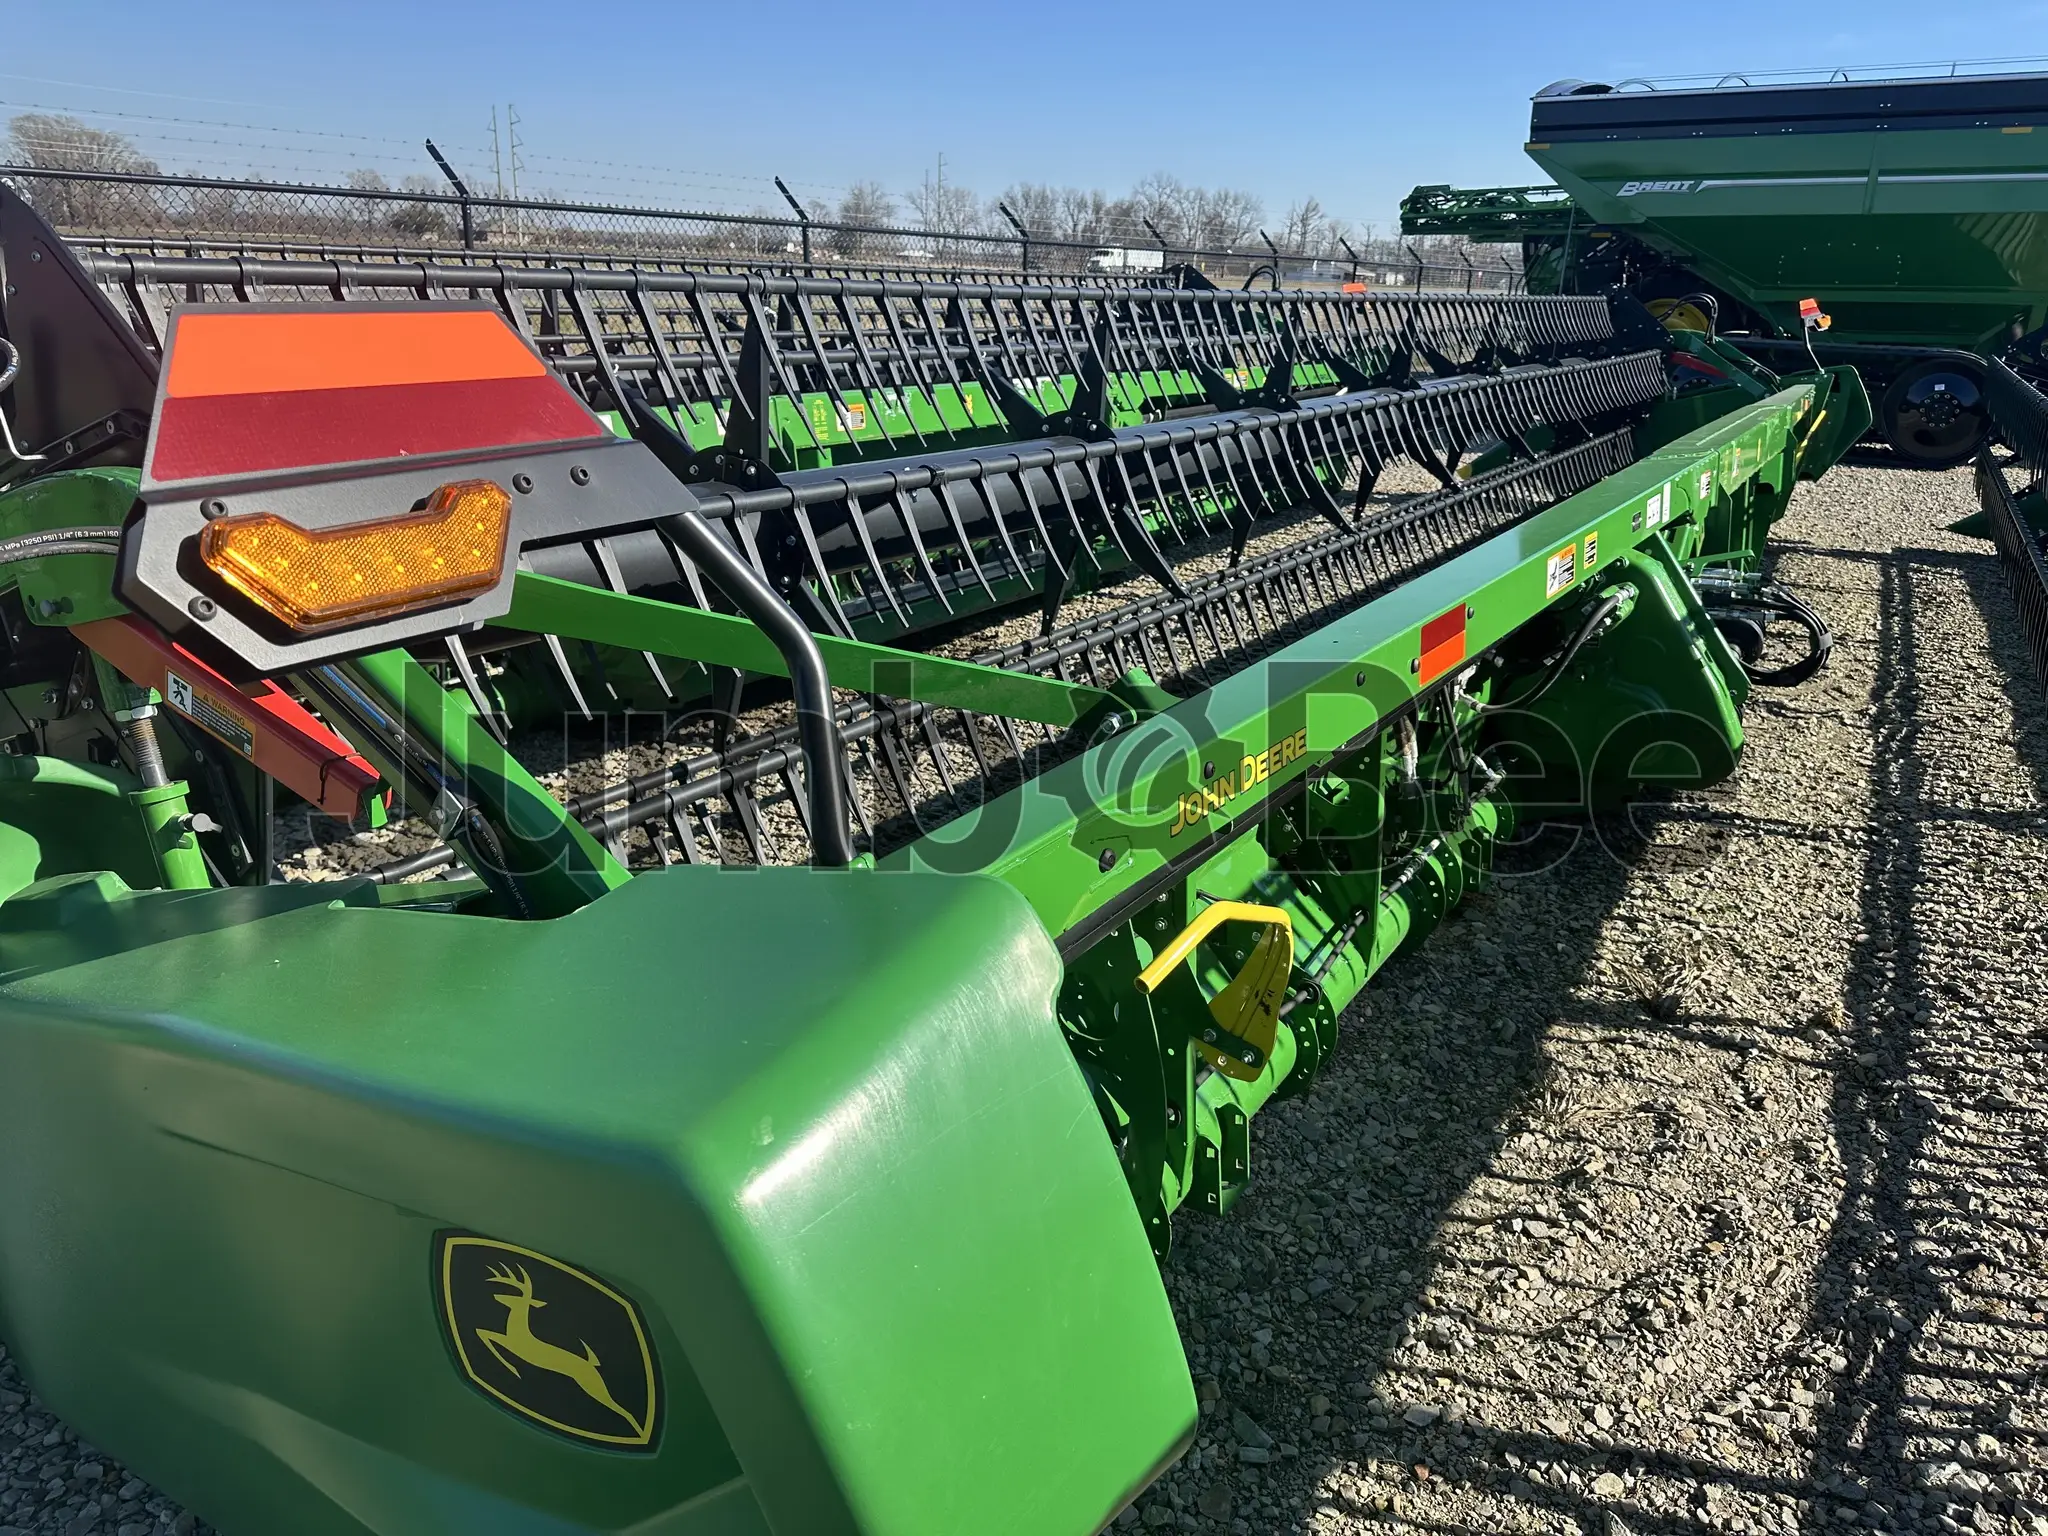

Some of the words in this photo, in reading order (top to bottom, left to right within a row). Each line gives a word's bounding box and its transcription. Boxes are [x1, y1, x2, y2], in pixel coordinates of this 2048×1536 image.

[1616, 181, 1695, 197] BRENT
[4, 541, 21, 551] MPa
[106, 530, 120, 538] ISO
[211, 697, 246, 727] WARNING
[1170, 768, 1236, 838] JOHN
[1239, 726, 1308, 794] DEERE
